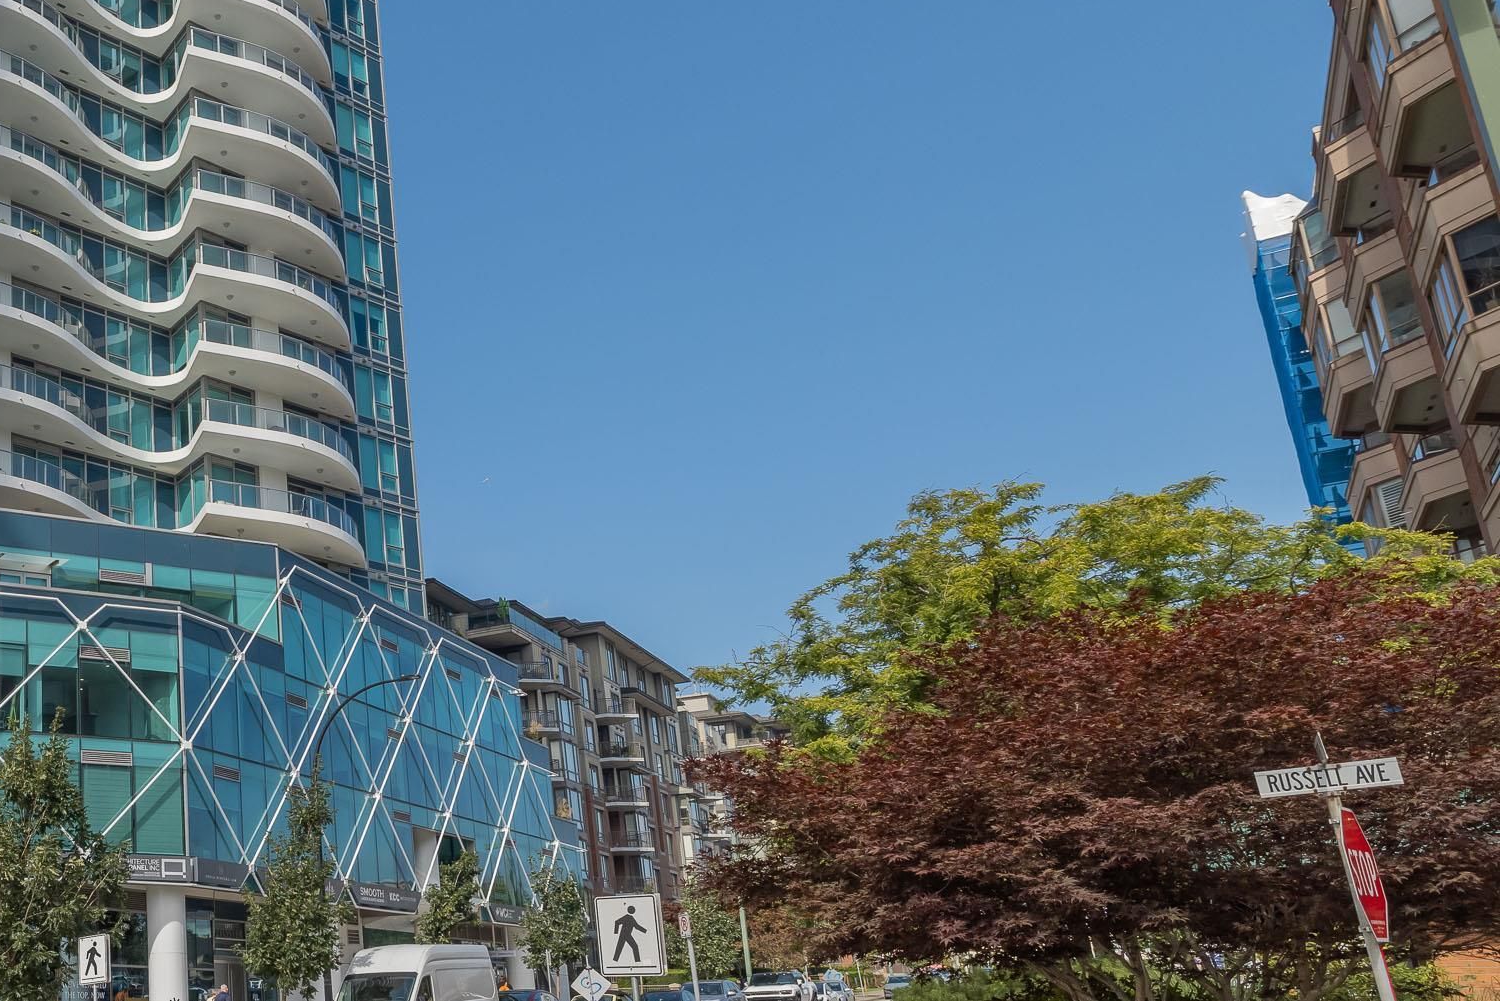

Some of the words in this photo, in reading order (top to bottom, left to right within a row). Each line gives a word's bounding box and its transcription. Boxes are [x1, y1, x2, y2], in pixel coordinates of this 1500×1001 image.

[1266, 767, 1349, 793] RUSSELL
[1356, 762, 1390, 785] AVE
[128, 858, 160, 866] HITECTURE
[1347, 848, 1379, 898] STOP
[360, 886, 385, 898] SMOOTH
